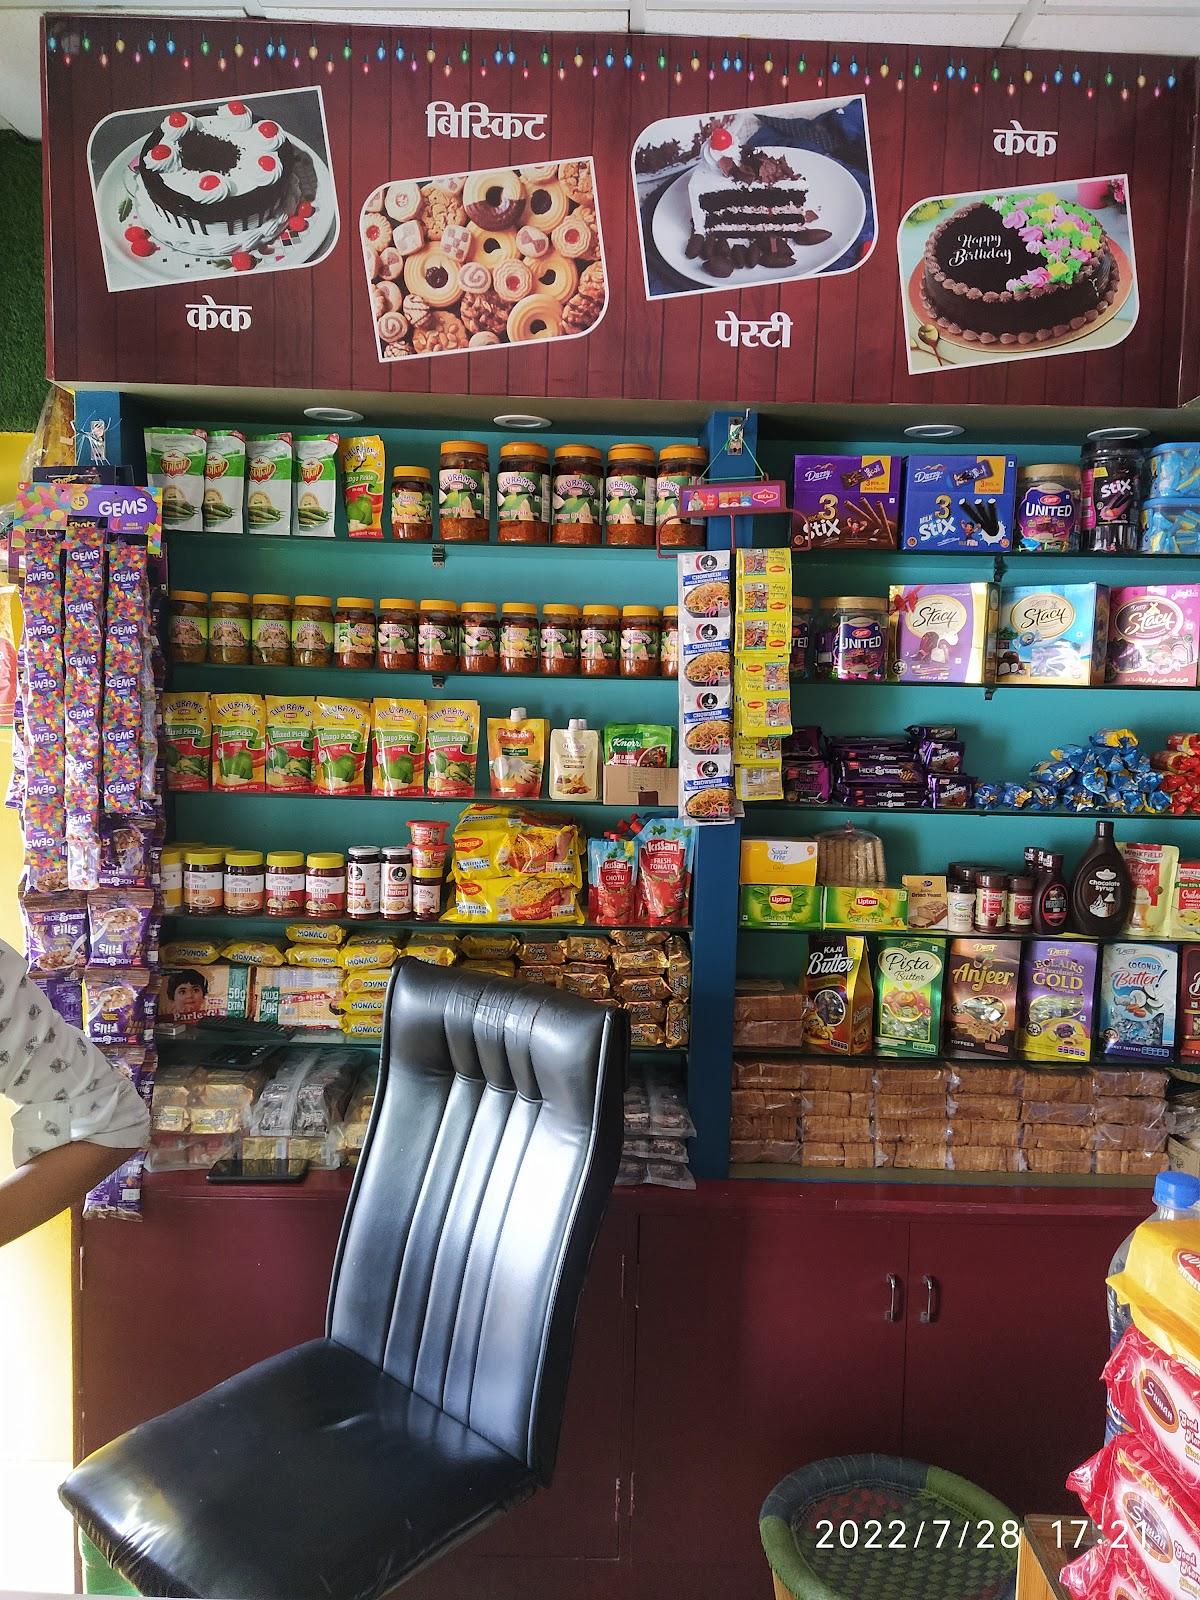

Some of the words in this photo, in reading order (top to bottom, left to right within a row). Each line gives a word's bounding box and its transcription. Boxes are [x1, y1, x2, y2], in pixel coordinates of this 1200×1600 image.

[425, 100, 547, 141] बिस्किट
[992, 120, 1059, 157] केक
[958, 233, 1002, 249] Happy
[949, 246, 1012, 268] Birthday
[185, 295, 252, 331] केक
[715, 311, 793, 349] पेस्टी
[98, 498, 148, 517] GEMS
[819, 494, 838, 519] 3
[935, 494, 952, 519] 3
[1025, 501, 1072, 517] UNITED
[71, 549, 99, 562] GEMS
[112, 571, 140, 583] GEMS
[691, 572, 722, 580] CHOWMEIN
[68, 602, 94, 613] GEMS
[913, 606, 960, 628] Stacy
[1020, 607, 1067, 629] Stacy
[110, 624, 138, 635] GEMS
[1123, 612, 1176, 635] Stacy
[692, 641, 722, 649] CHOWMEIN
[841, 635, 882, 651] UNITED
[69, 654, 97, 666] GEMS
[108, 677, 136, 689] GEMS
[68, 708, 95, 720] GEMS
[107, 729, 135, 741] GEMS
[612, 737, 642, 748] Knorr
[108, 782, 135, 794] GEMS
[455, 840, 482, 849] Maggi
[647, 840, 679, 853] kissan
[770, 848, 788, 857] Sugar
[1088, 879, 1121, 887] Chocolate
[1094, 885, 1114, 893] Syrup
[770, 895, 791, 904] Lipton
[857, 898, 877, 906] Lipton
[298, 930, 328, 939] MONACO
[98, 943, 124, 955] Fills
[528, 946, 546, 954] Krack
[823, 945, 845, 955] KAJU
[231, 952, 262, 963] MONACO
[346, 956, 378, 967] MONACO
[806, 950, 854, 976] Butter
[885, 950, 933, 972] Pista
[1034, 957, 1085, 975] ECLAIRS
[1127, 960, 1162, 971] COCONUT
[894, 970, 925, 983] Butter
[952, 962, 1014, 992] Anjeer
[1031, 972, 1083, 990] GOLD
[363, 980, 388, 989] ONACO
[228, 988, 246, 1000] 50g
[261, 990, 279, 1000] EXTRA
[227, 1001, 246, 1011] EXTRA
[260, 1001, 278, 1014] 50g
[351, 1001, 383, 1010] MONACO
[632, 1006, 650, 1014] Krack
[173, 1009, 216, 1021] Parle-G
[93, 1022, 118, 1034] Fills
[351, 1025, 383, 1034] MONACO
[1144, 1381, 1174, 1422] Suman
